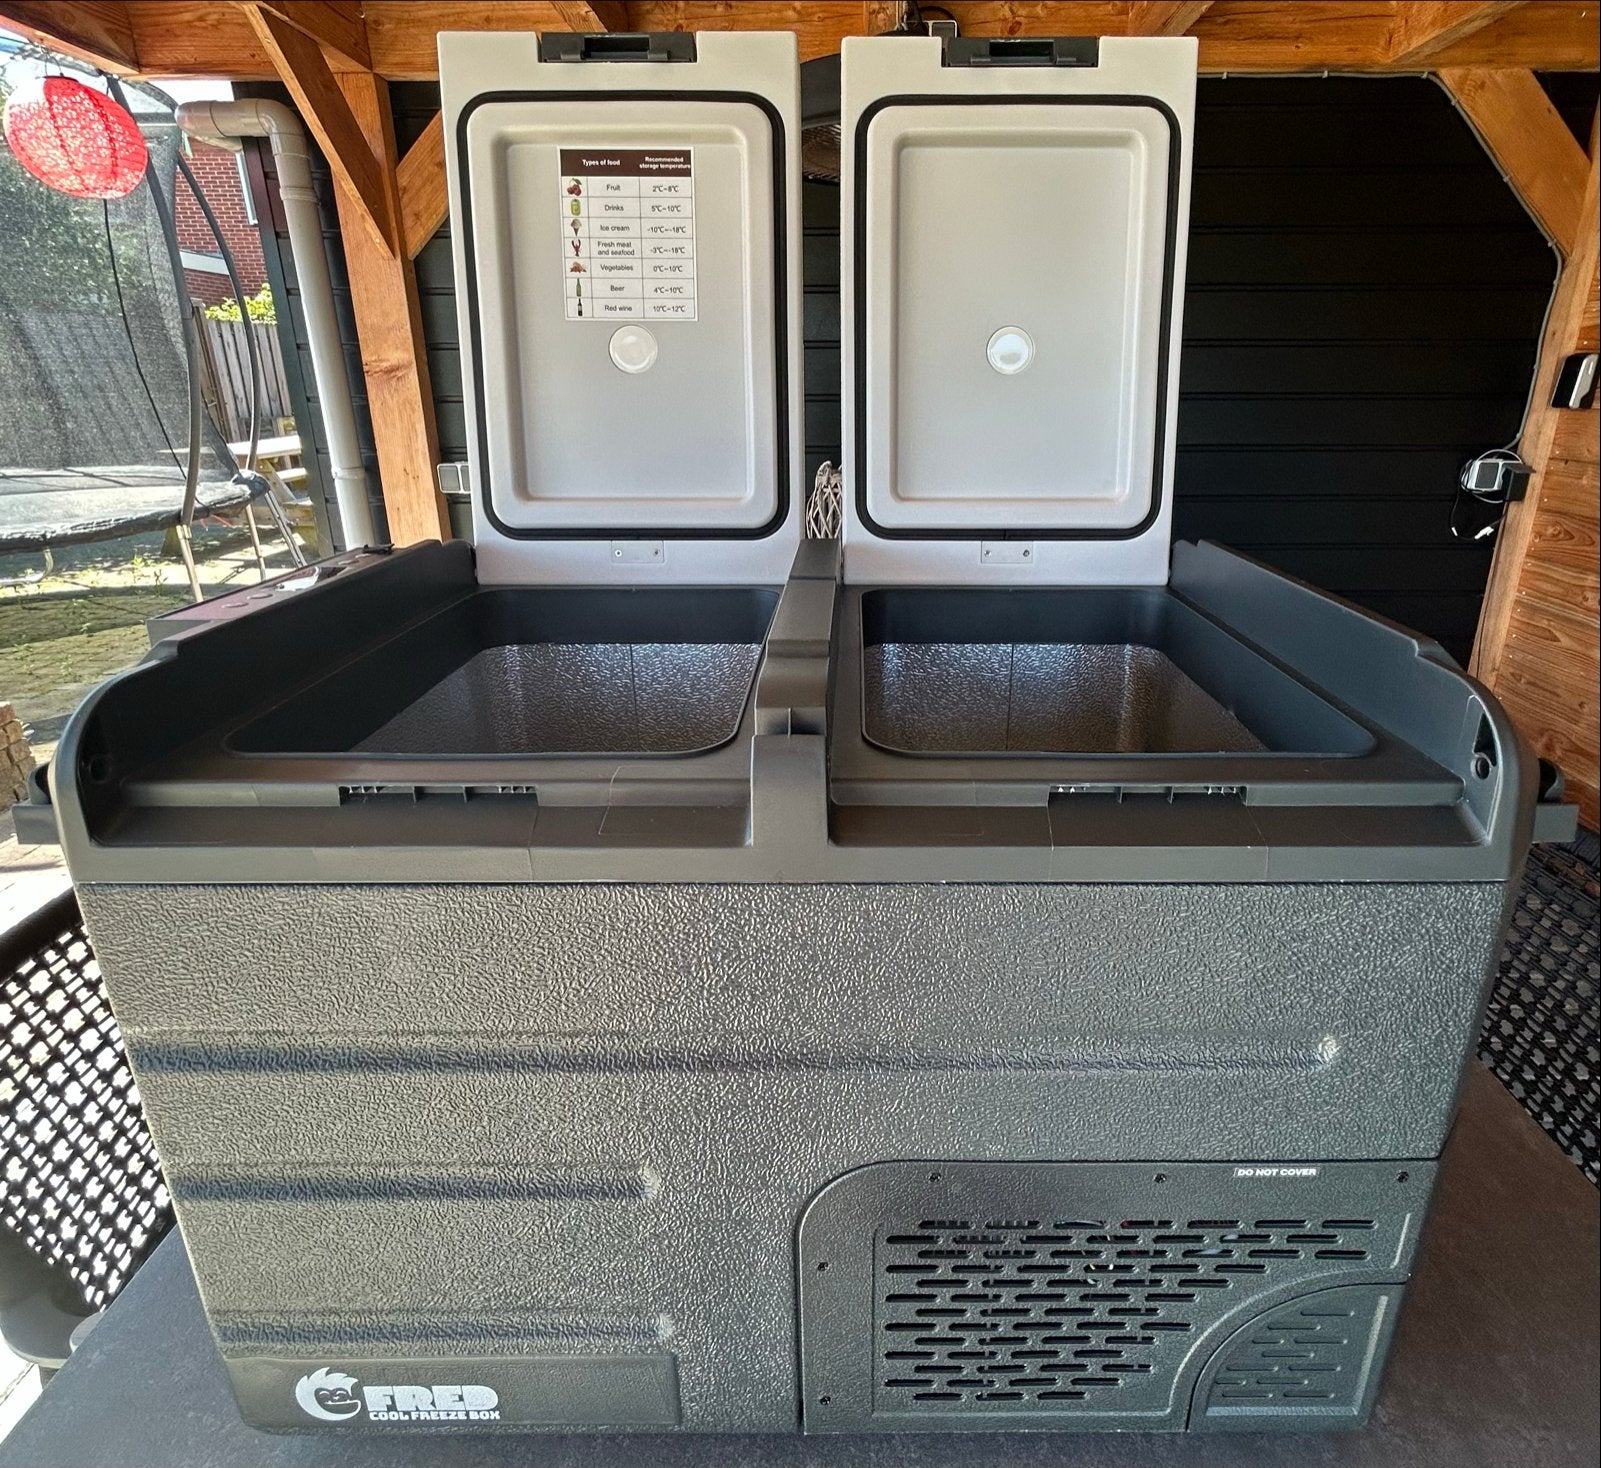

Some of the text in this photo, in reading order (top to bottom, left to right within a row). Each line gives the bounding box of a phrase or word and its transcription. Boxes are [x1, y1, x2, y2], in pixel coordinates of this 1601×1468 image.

[582, 159, 599, 167] Types
[604, 204, 624, 212] Drinks
[600, 264, 634, 272] Vegetables
[1237, 1168, 1317, 1176] DO NOT COVER
[363, 1385, 499, 1411] FRED
[369, 1410, 500, 1421] COOL FREEZE BOX
